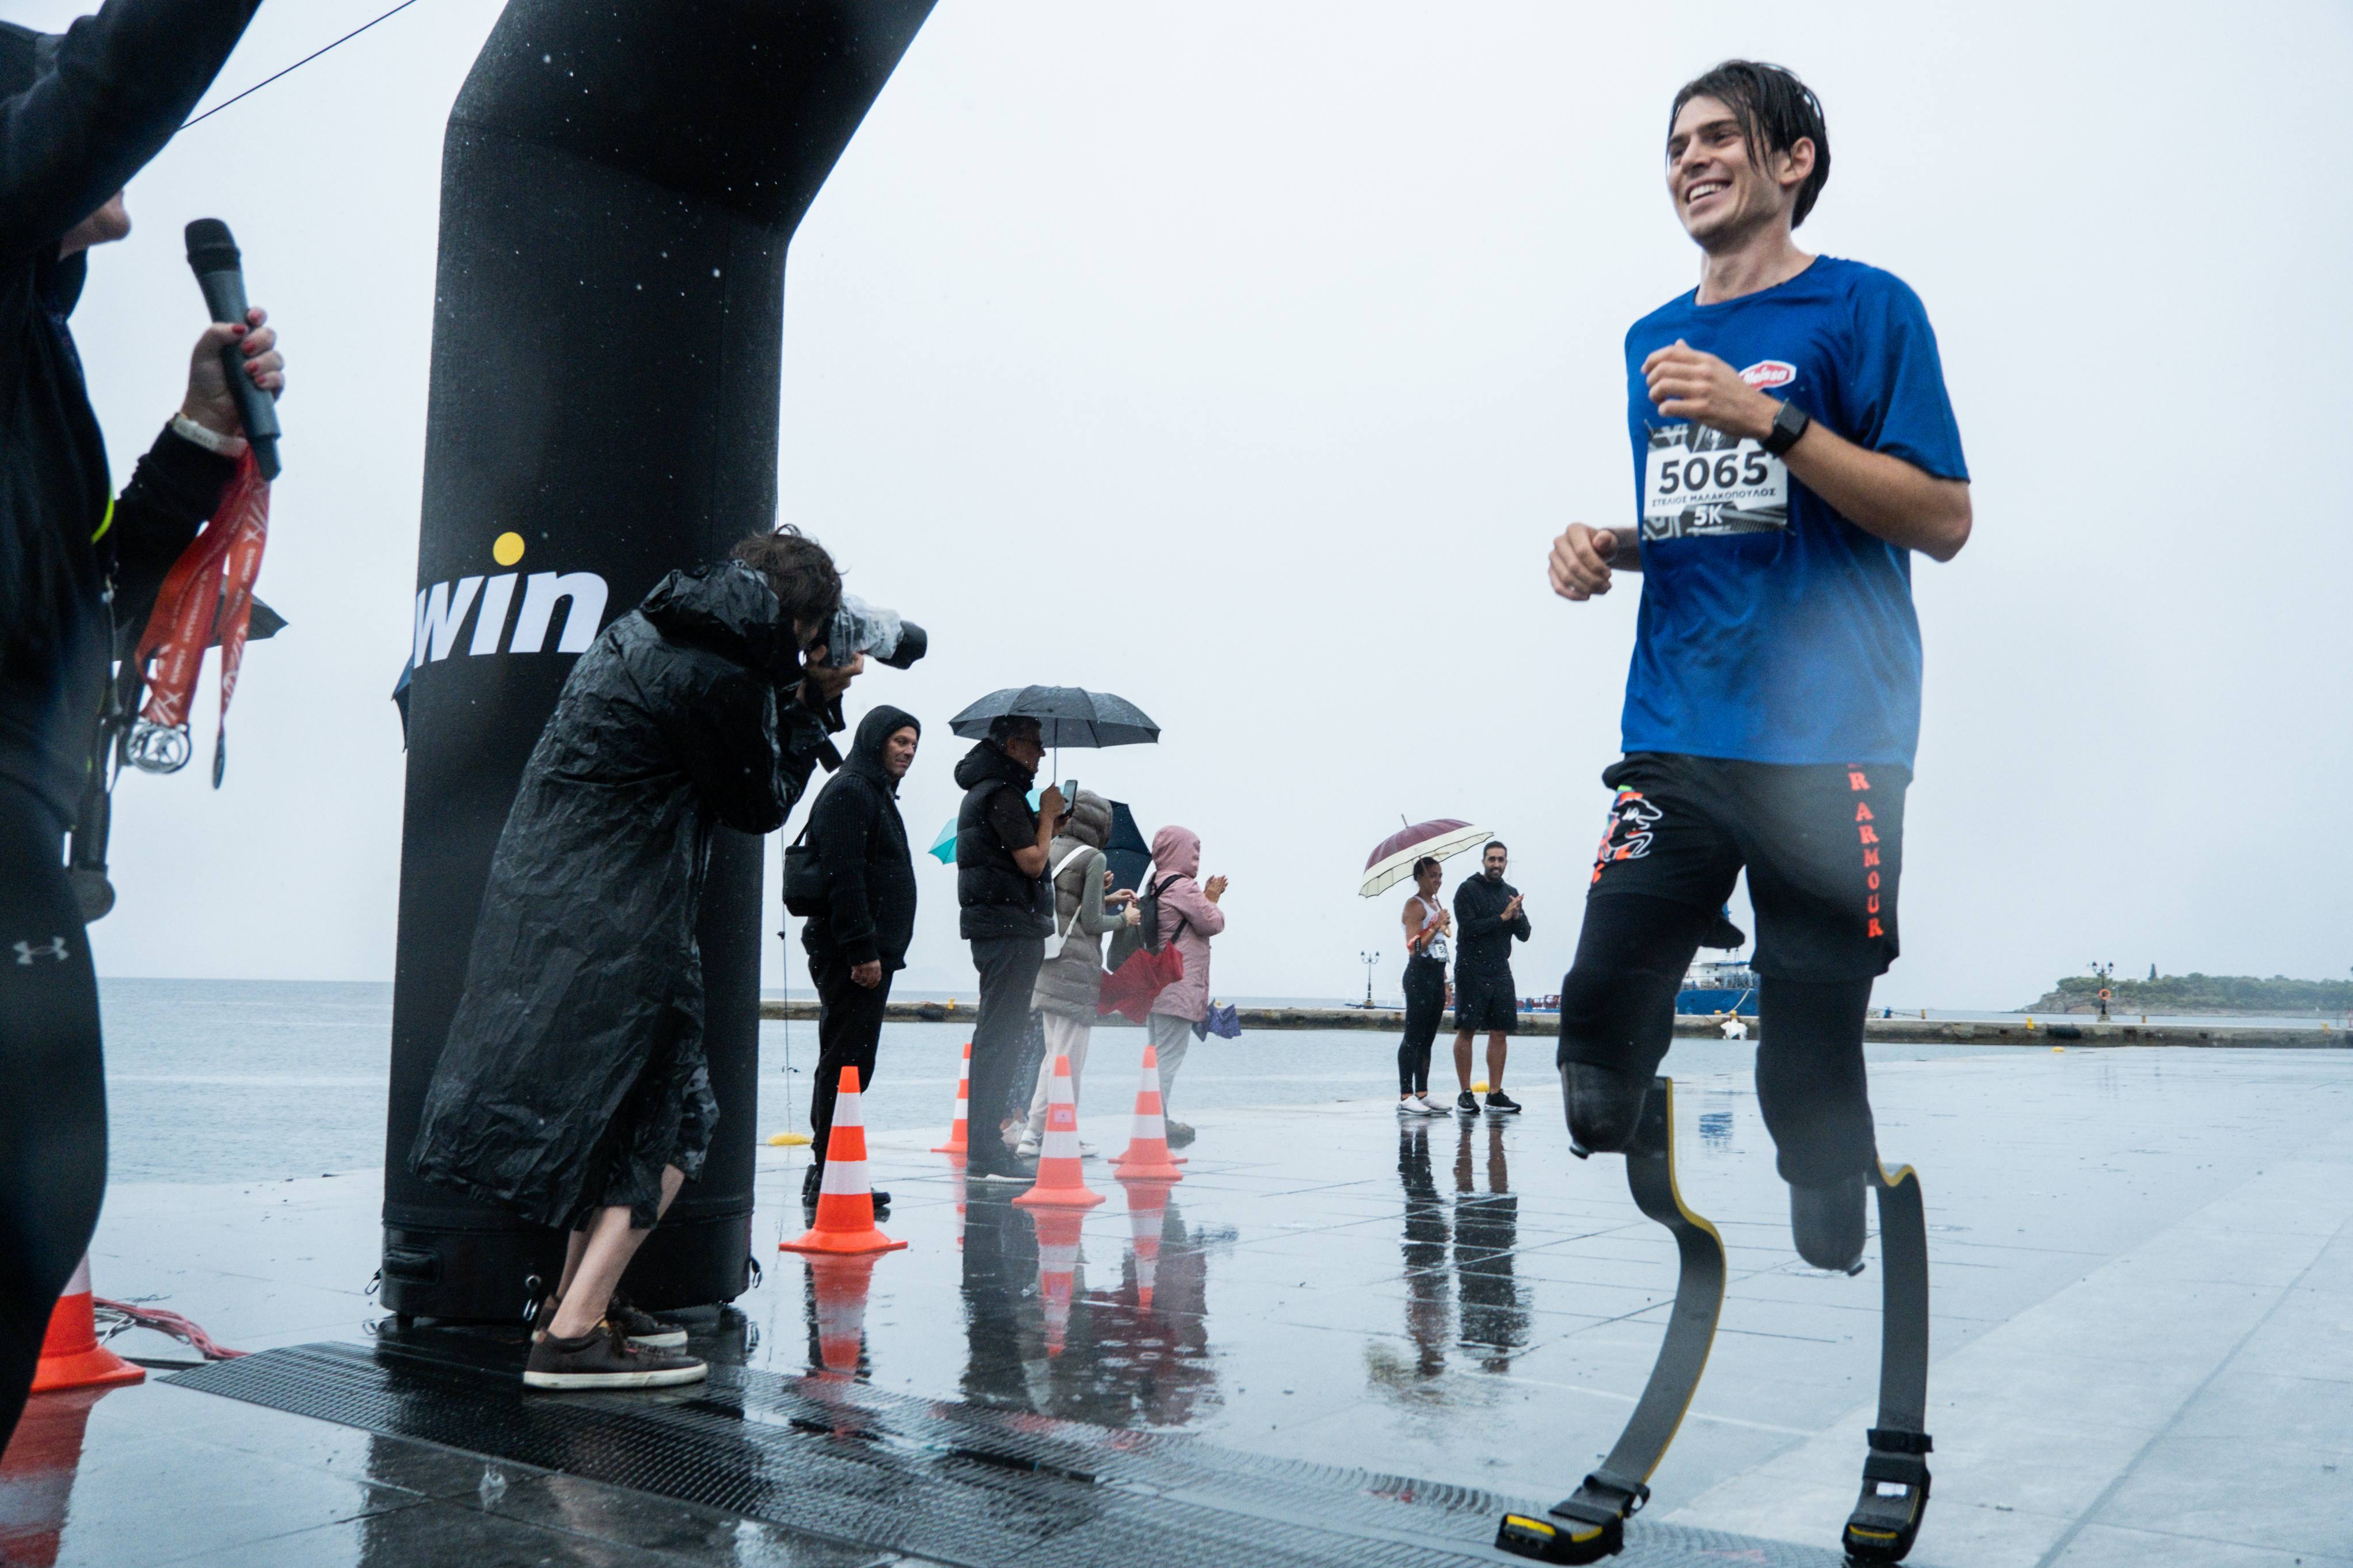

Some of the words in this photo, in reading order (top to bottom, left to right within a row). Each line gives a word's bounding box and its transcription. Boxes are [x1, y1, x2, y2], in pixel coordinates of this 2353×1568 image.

[1659, 451, 1768, 494] 5065
[1651, 496, 1688, 508] ΣΤΕΛΙΟΣ
[1690, 489, 1776, 502] ΜΑΛΑΚΟΠΟΥΛΟΣ
[1693, 503, 1723, 526] 5K
[1855, 802, 1883, 937] ARMOUR
